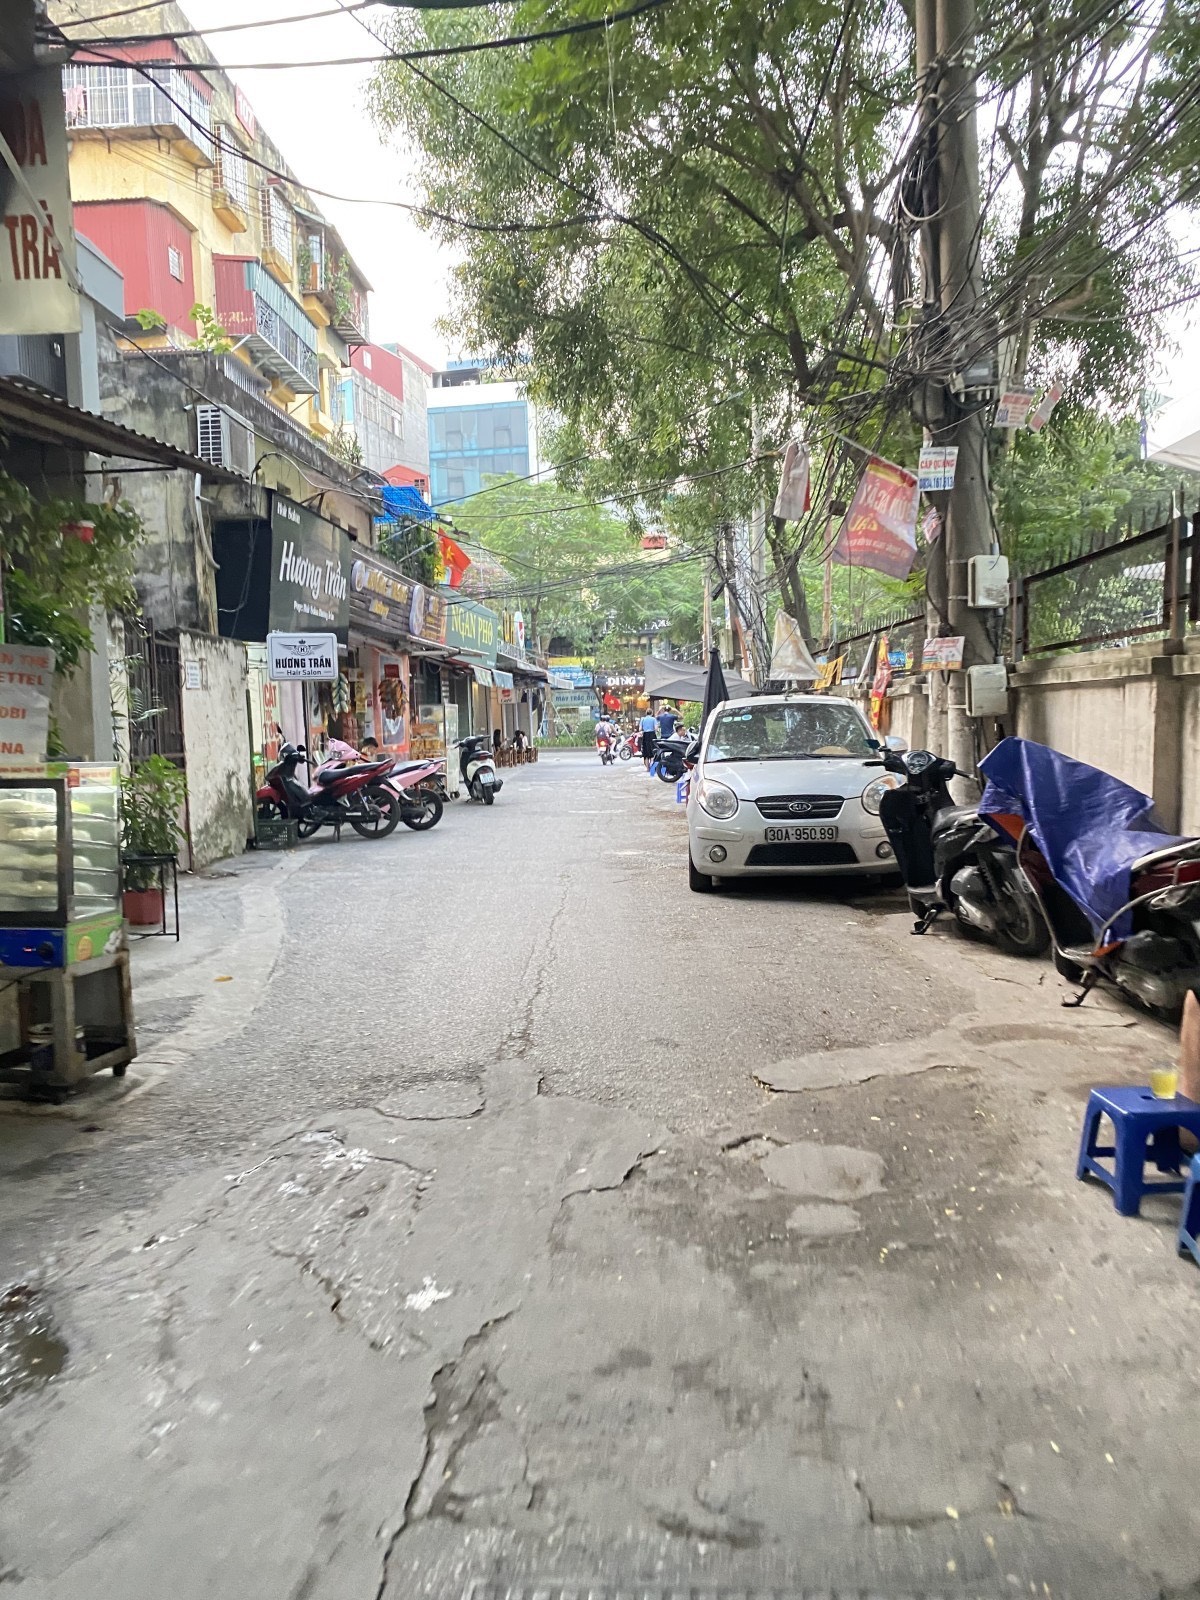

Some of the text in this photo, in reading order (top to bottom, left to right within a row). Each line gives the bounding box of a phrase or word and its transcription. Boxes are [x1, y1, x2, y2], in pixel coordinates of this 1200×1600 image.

[4, 200, 61, 280] TRÀ
[280, 540, 322, 600] Hương
[324, 560, 347, 601] Trần
[275, 654, 332, 669] HƯƠNG TRẦN
[768, 827, 834, 841] 30A-950.89
